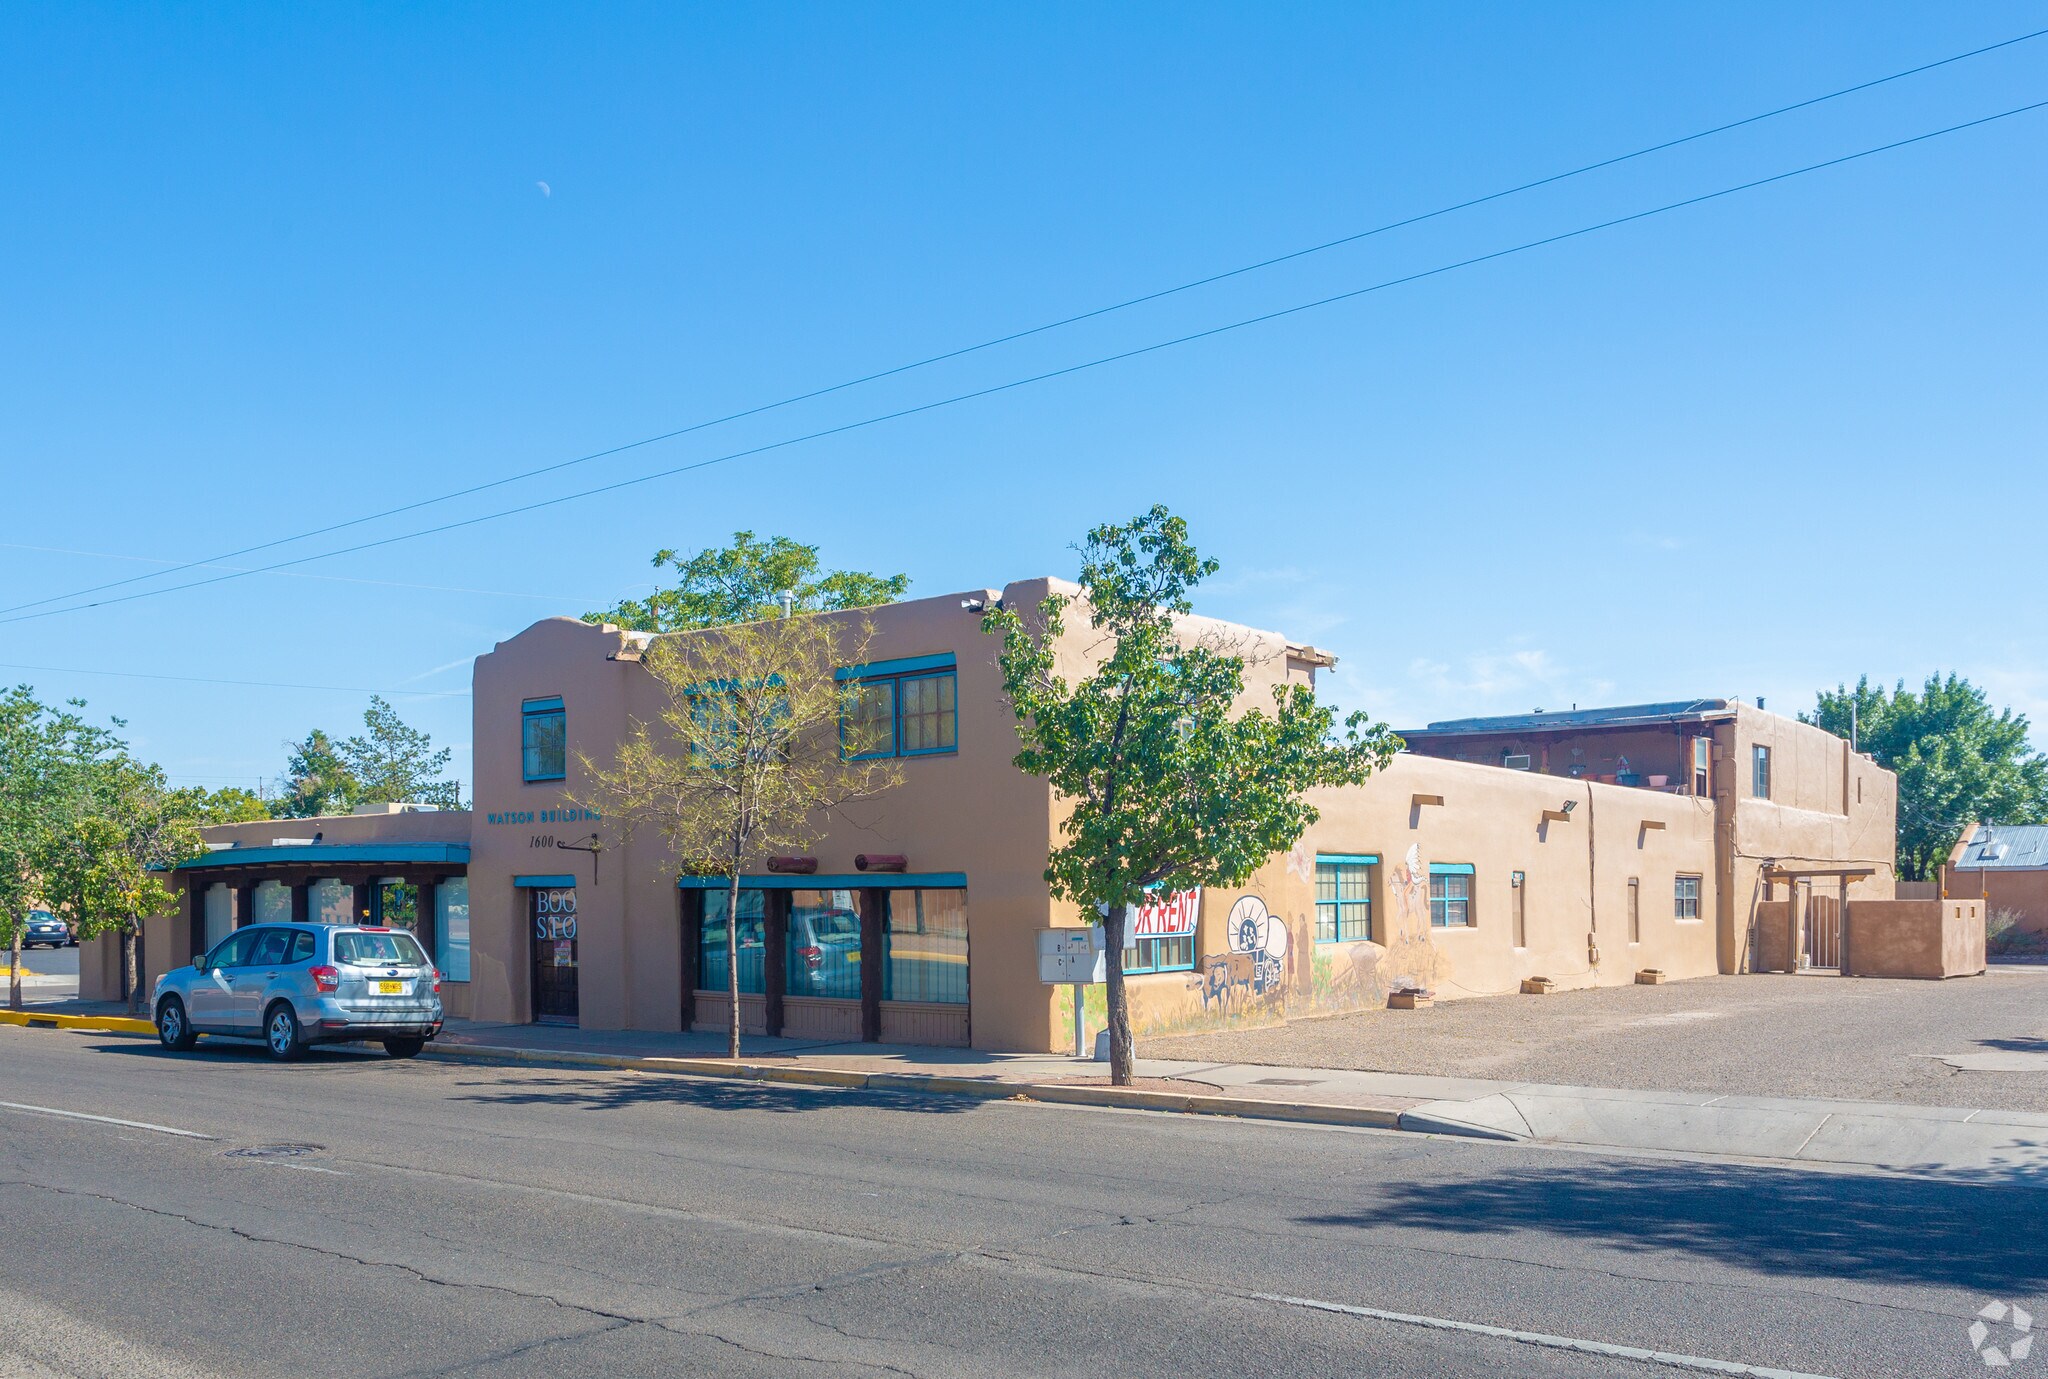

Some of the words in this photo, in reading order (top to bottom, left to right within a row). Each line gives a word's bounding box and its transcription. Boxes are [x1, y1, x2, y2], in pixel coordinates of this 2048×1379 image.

[487, 811, 535, 825] WATSON
[540, 808, 602, 824] BUILDING
[530, 835, 554, 848] 1600
[1157, 891, 1197, 933] RENT
[536, 916, 577, 939] STO
